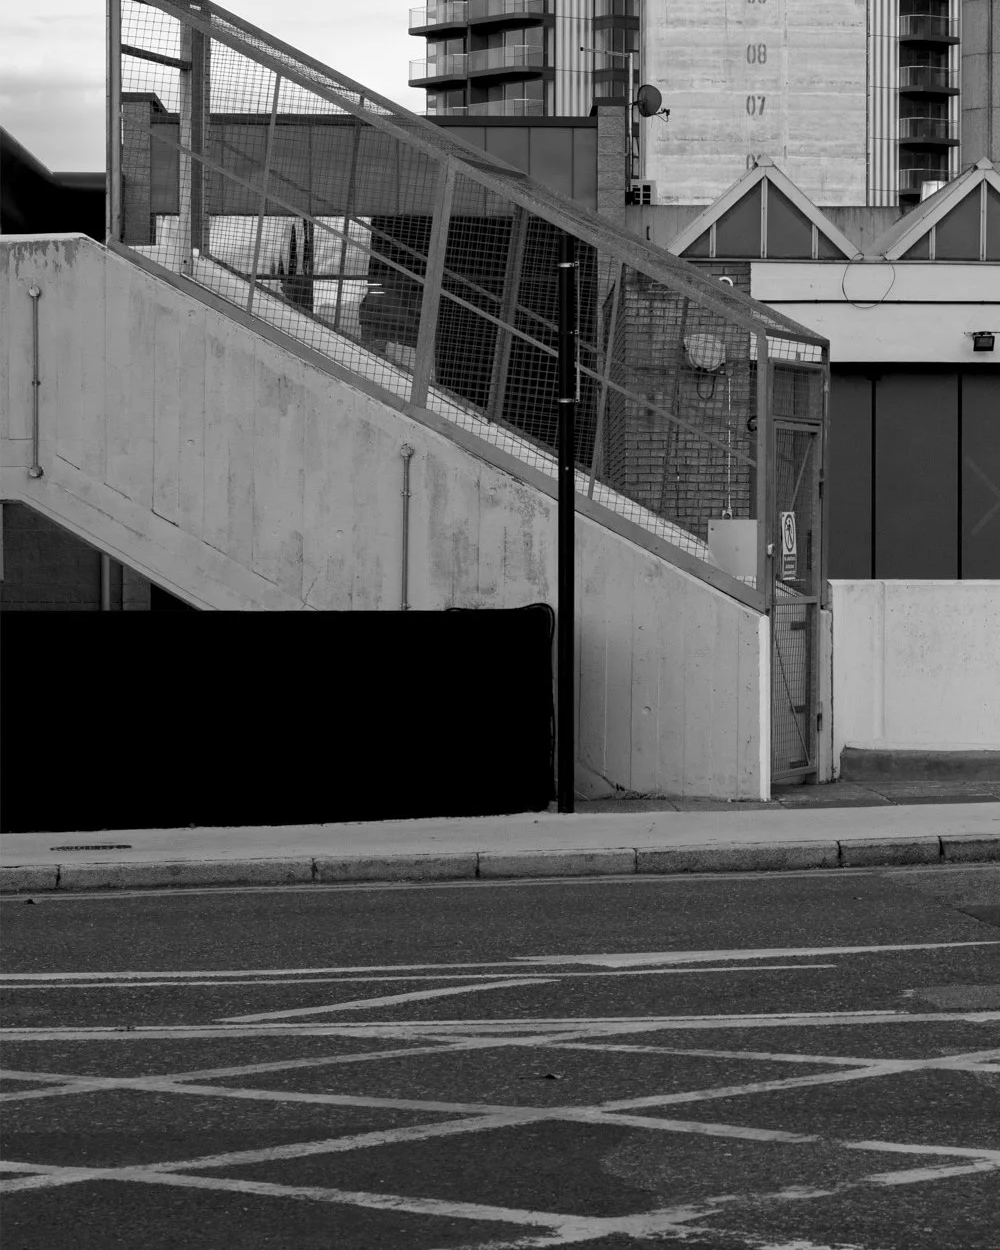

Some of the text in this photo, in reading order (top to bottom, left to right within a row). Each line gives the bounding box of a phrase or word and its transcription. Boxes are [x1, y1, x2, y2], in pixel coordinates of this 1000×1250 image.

[747, 43, 767, 64] 08
[746, 95, 766, 116] 07
[746, 153, 763, 170] 0
